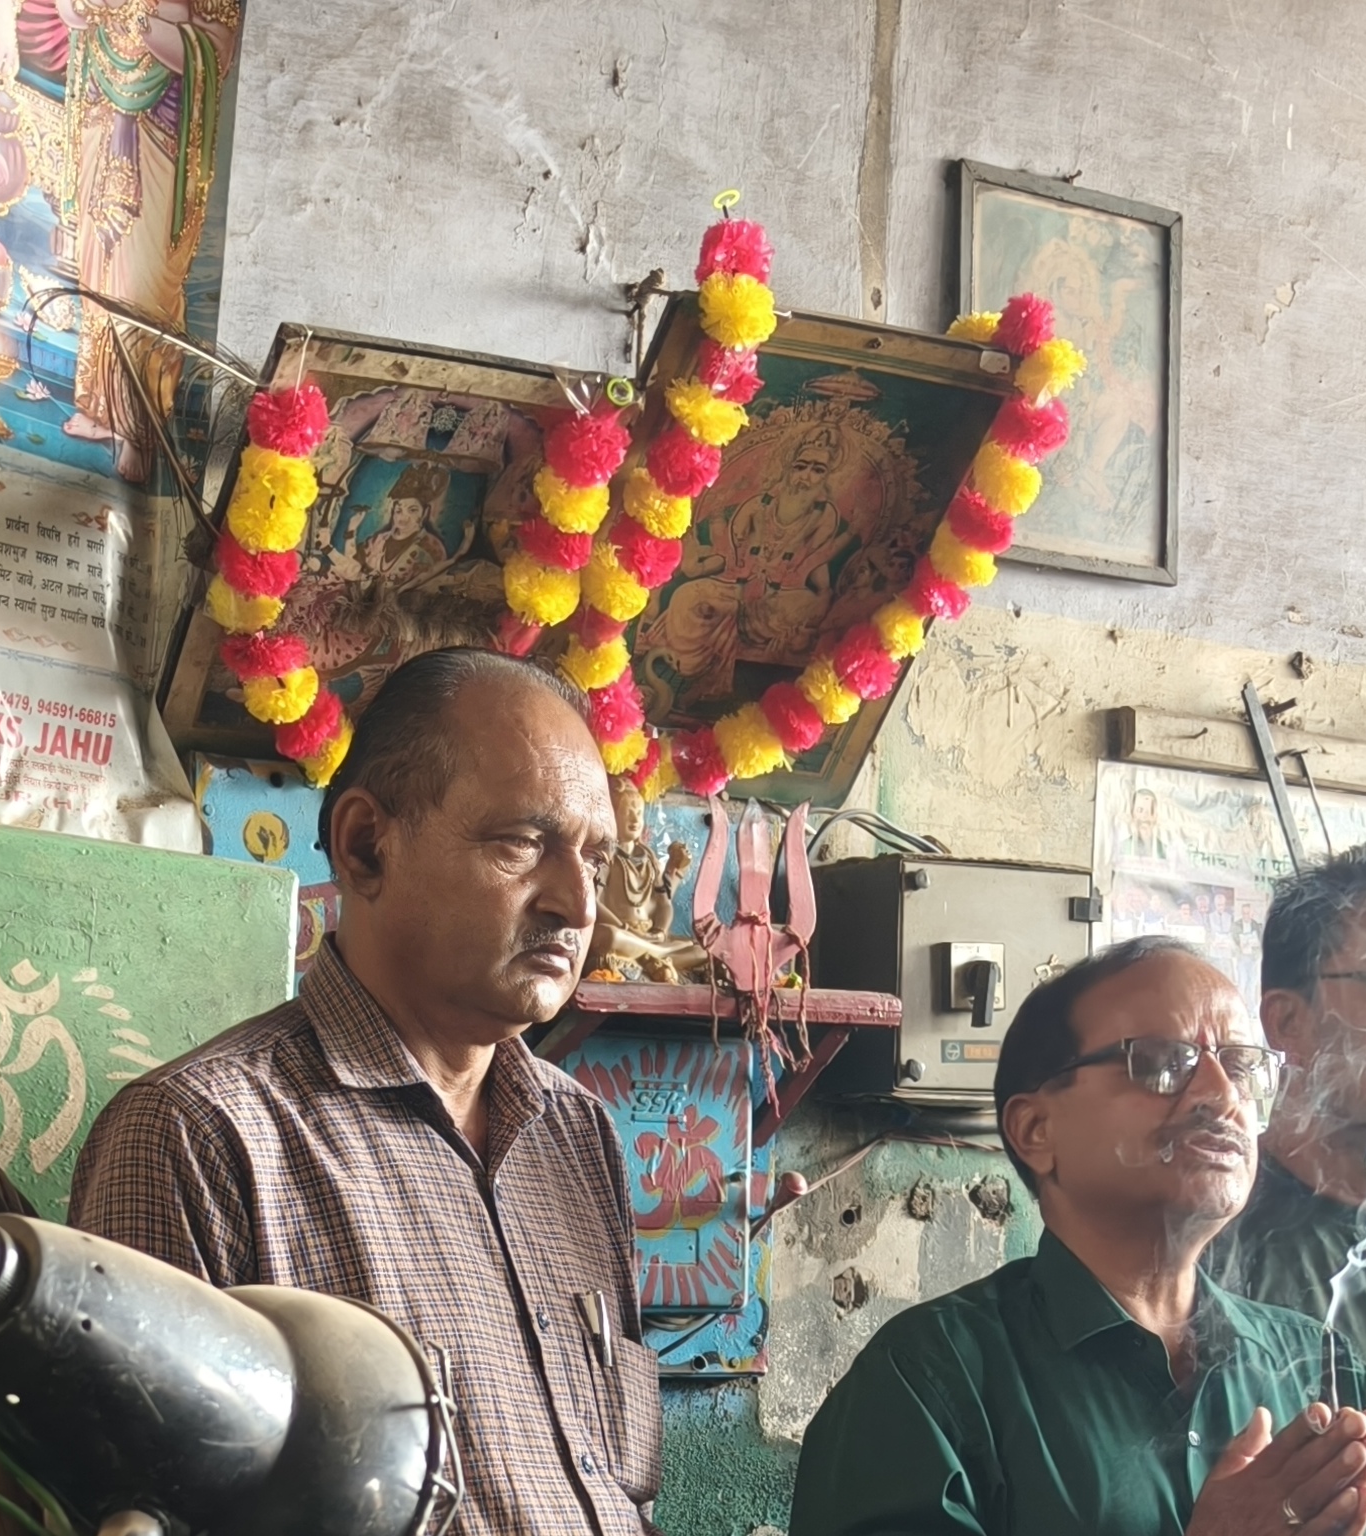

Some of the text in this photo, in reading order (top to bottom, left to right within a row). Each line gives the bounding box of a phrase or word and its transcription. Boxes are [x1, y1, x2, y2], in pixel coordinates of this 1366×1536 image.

[36, 550, 58, 568] सकल
[41, 578, 63, 594] अटल
[38, 699, 116, 728] 94591-66815
[33, 723, 113, 766] JAHU
